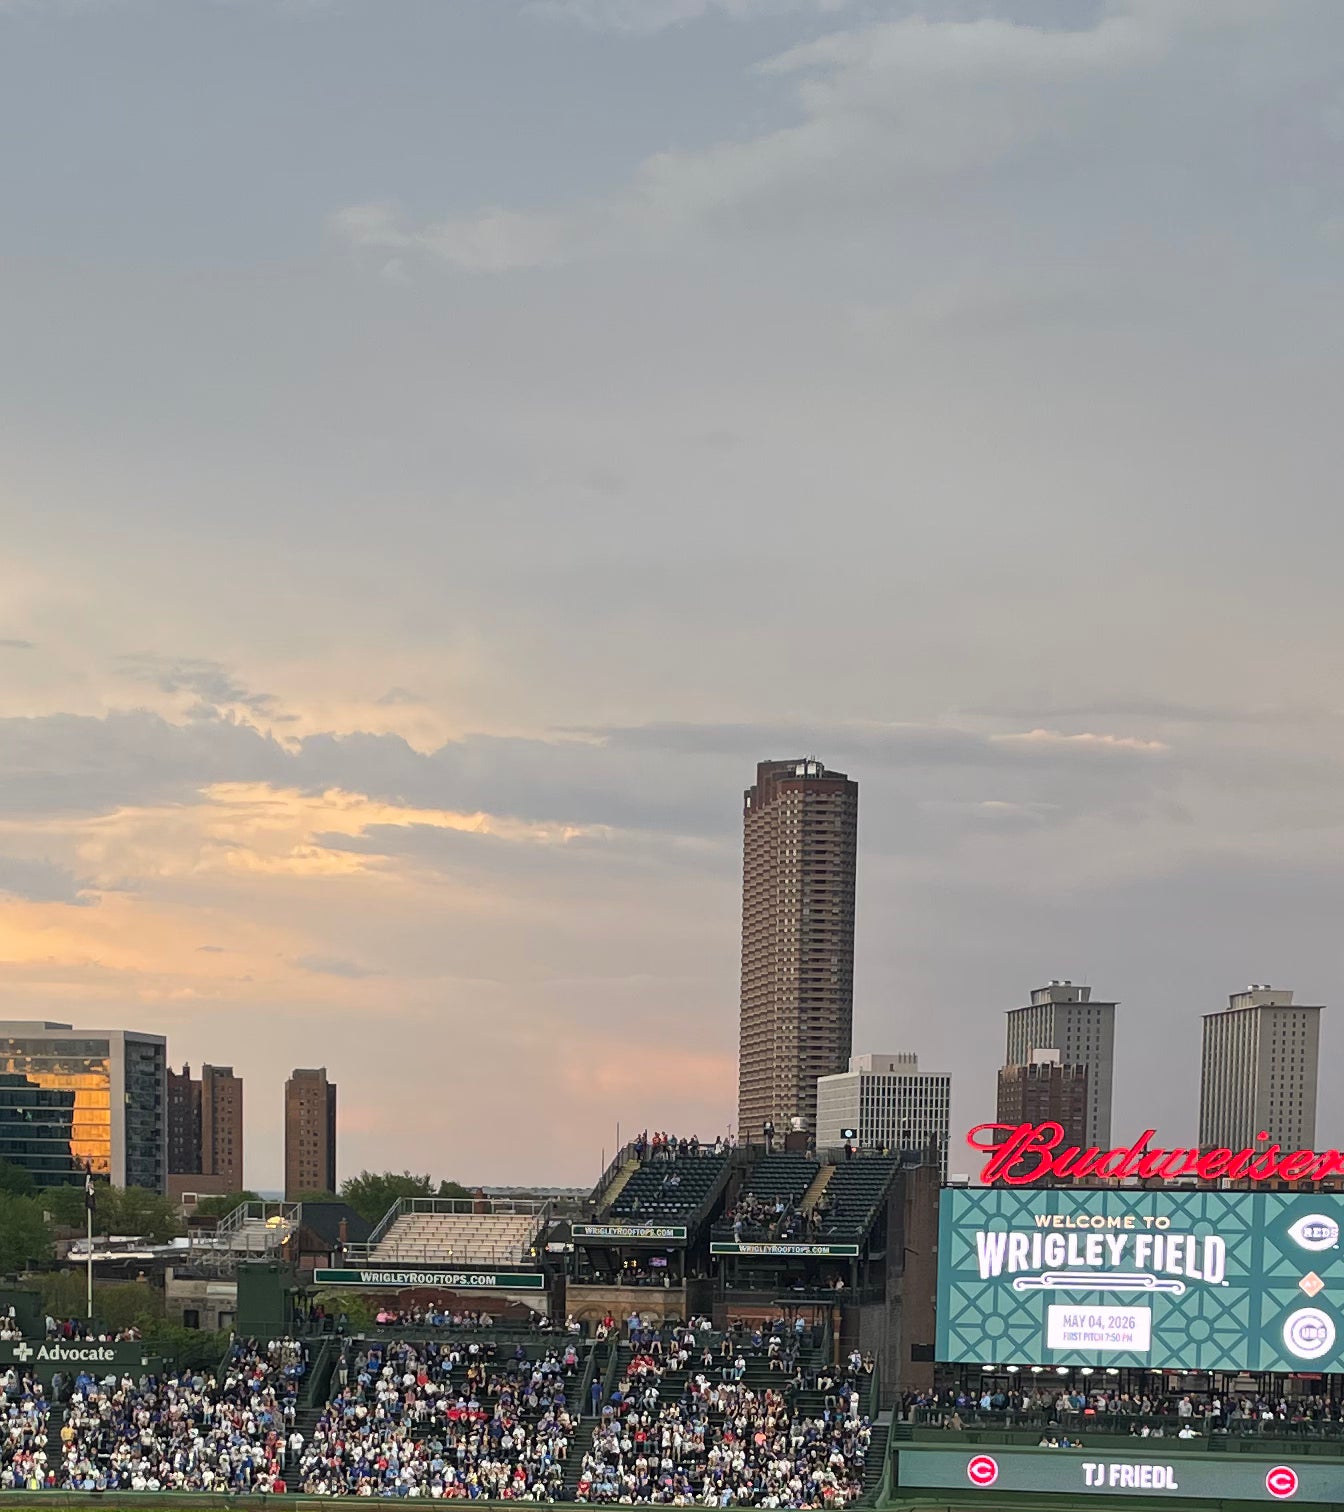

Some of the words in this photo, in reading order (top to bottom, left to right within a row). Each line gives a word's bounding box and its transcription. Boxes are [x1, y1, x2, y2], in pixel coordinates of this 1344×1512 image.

[1034, 1214, 1136, 1229] WELCOME
[1143, 1216, 1171, 1230] TO
[1303, 1226, 1339, 1239] REDS
[975, 1231, 1128, 1280] WRIGLEY
[1135, 1234, 1226, 1284] FIELD
[360, 1271, 496, 1285] WRIGLEYROOFTOPS.COM
[1063, 1314, 1086, 1328] MAY
[1088, 1315, 1106, 1330] 04,
[1108, 1316, 1136, 1329] 2026
[1063, 1331, 1082, 1341] FIRST
[1083, 1332, 1104, 1342] PITCH
[1105, 1332, 1121, 1342] 7:50
[1122, 1333, 1133, 1343] PM
[36, 1344, 115, 1361] Advocate
[1082, 1463, 1104, 1486] TJ
[1109, 1464, 1179, 1490] FRIEDL
